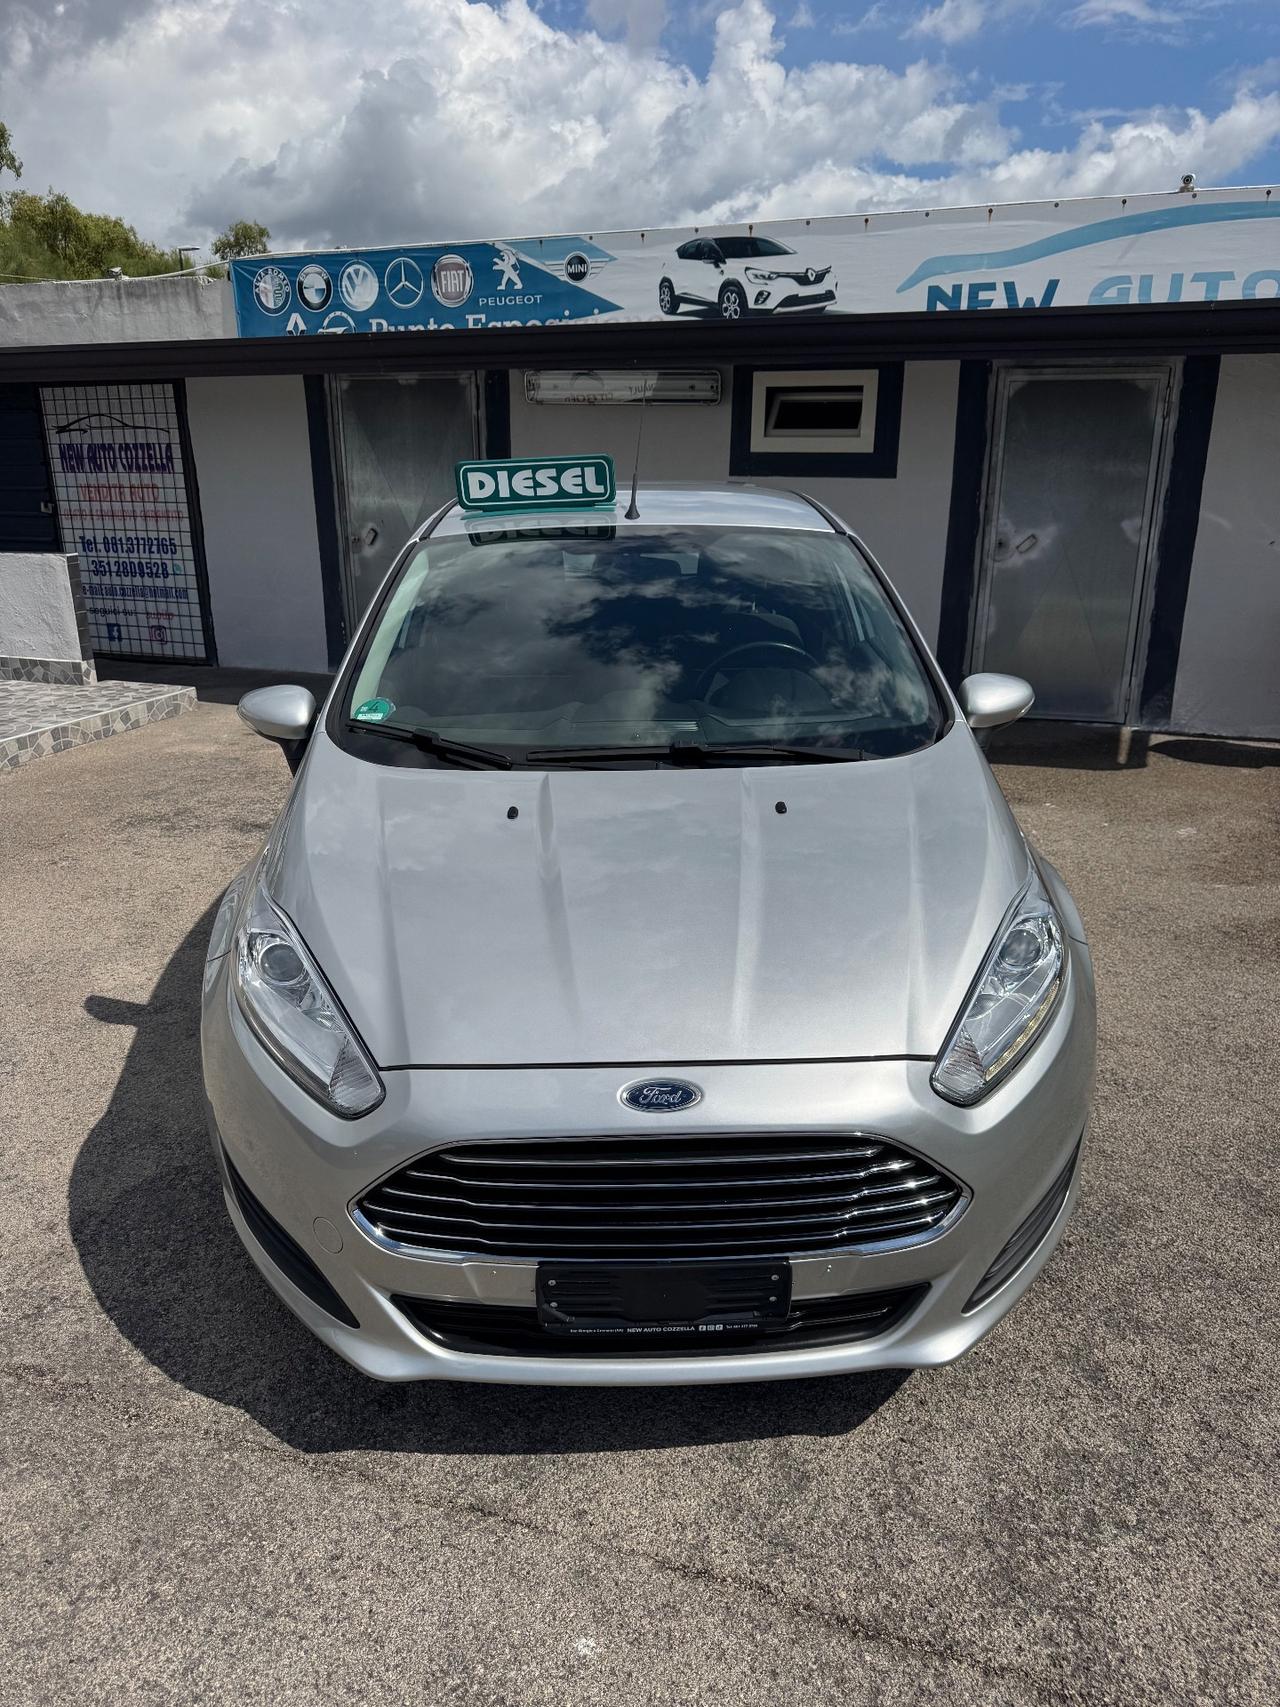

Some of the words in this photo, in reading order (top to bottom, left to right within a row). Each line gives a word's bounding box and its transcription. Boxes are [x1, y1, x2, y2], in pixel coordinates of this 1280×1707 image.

[566, 263, 588, 274] MINI
[440, 271, 465, 294] FIAT
[925, 279, 1060, 312] NEW
[1087, 270, 1280, 306] AUTO
[478, 294, 543, 307] PEUGEOT
[58, 443, 85, 473] NEW
[86, 443, 117, 474] AUTO
[118, 443, 175, 474] COZZELLA
[467, 466, 605, 500] DIESEL
[79, 535, 102, 554] Tel.
[638, 1086, 683, 1105] Ford
[662, 1325, 696, 1333] COZZELLA
